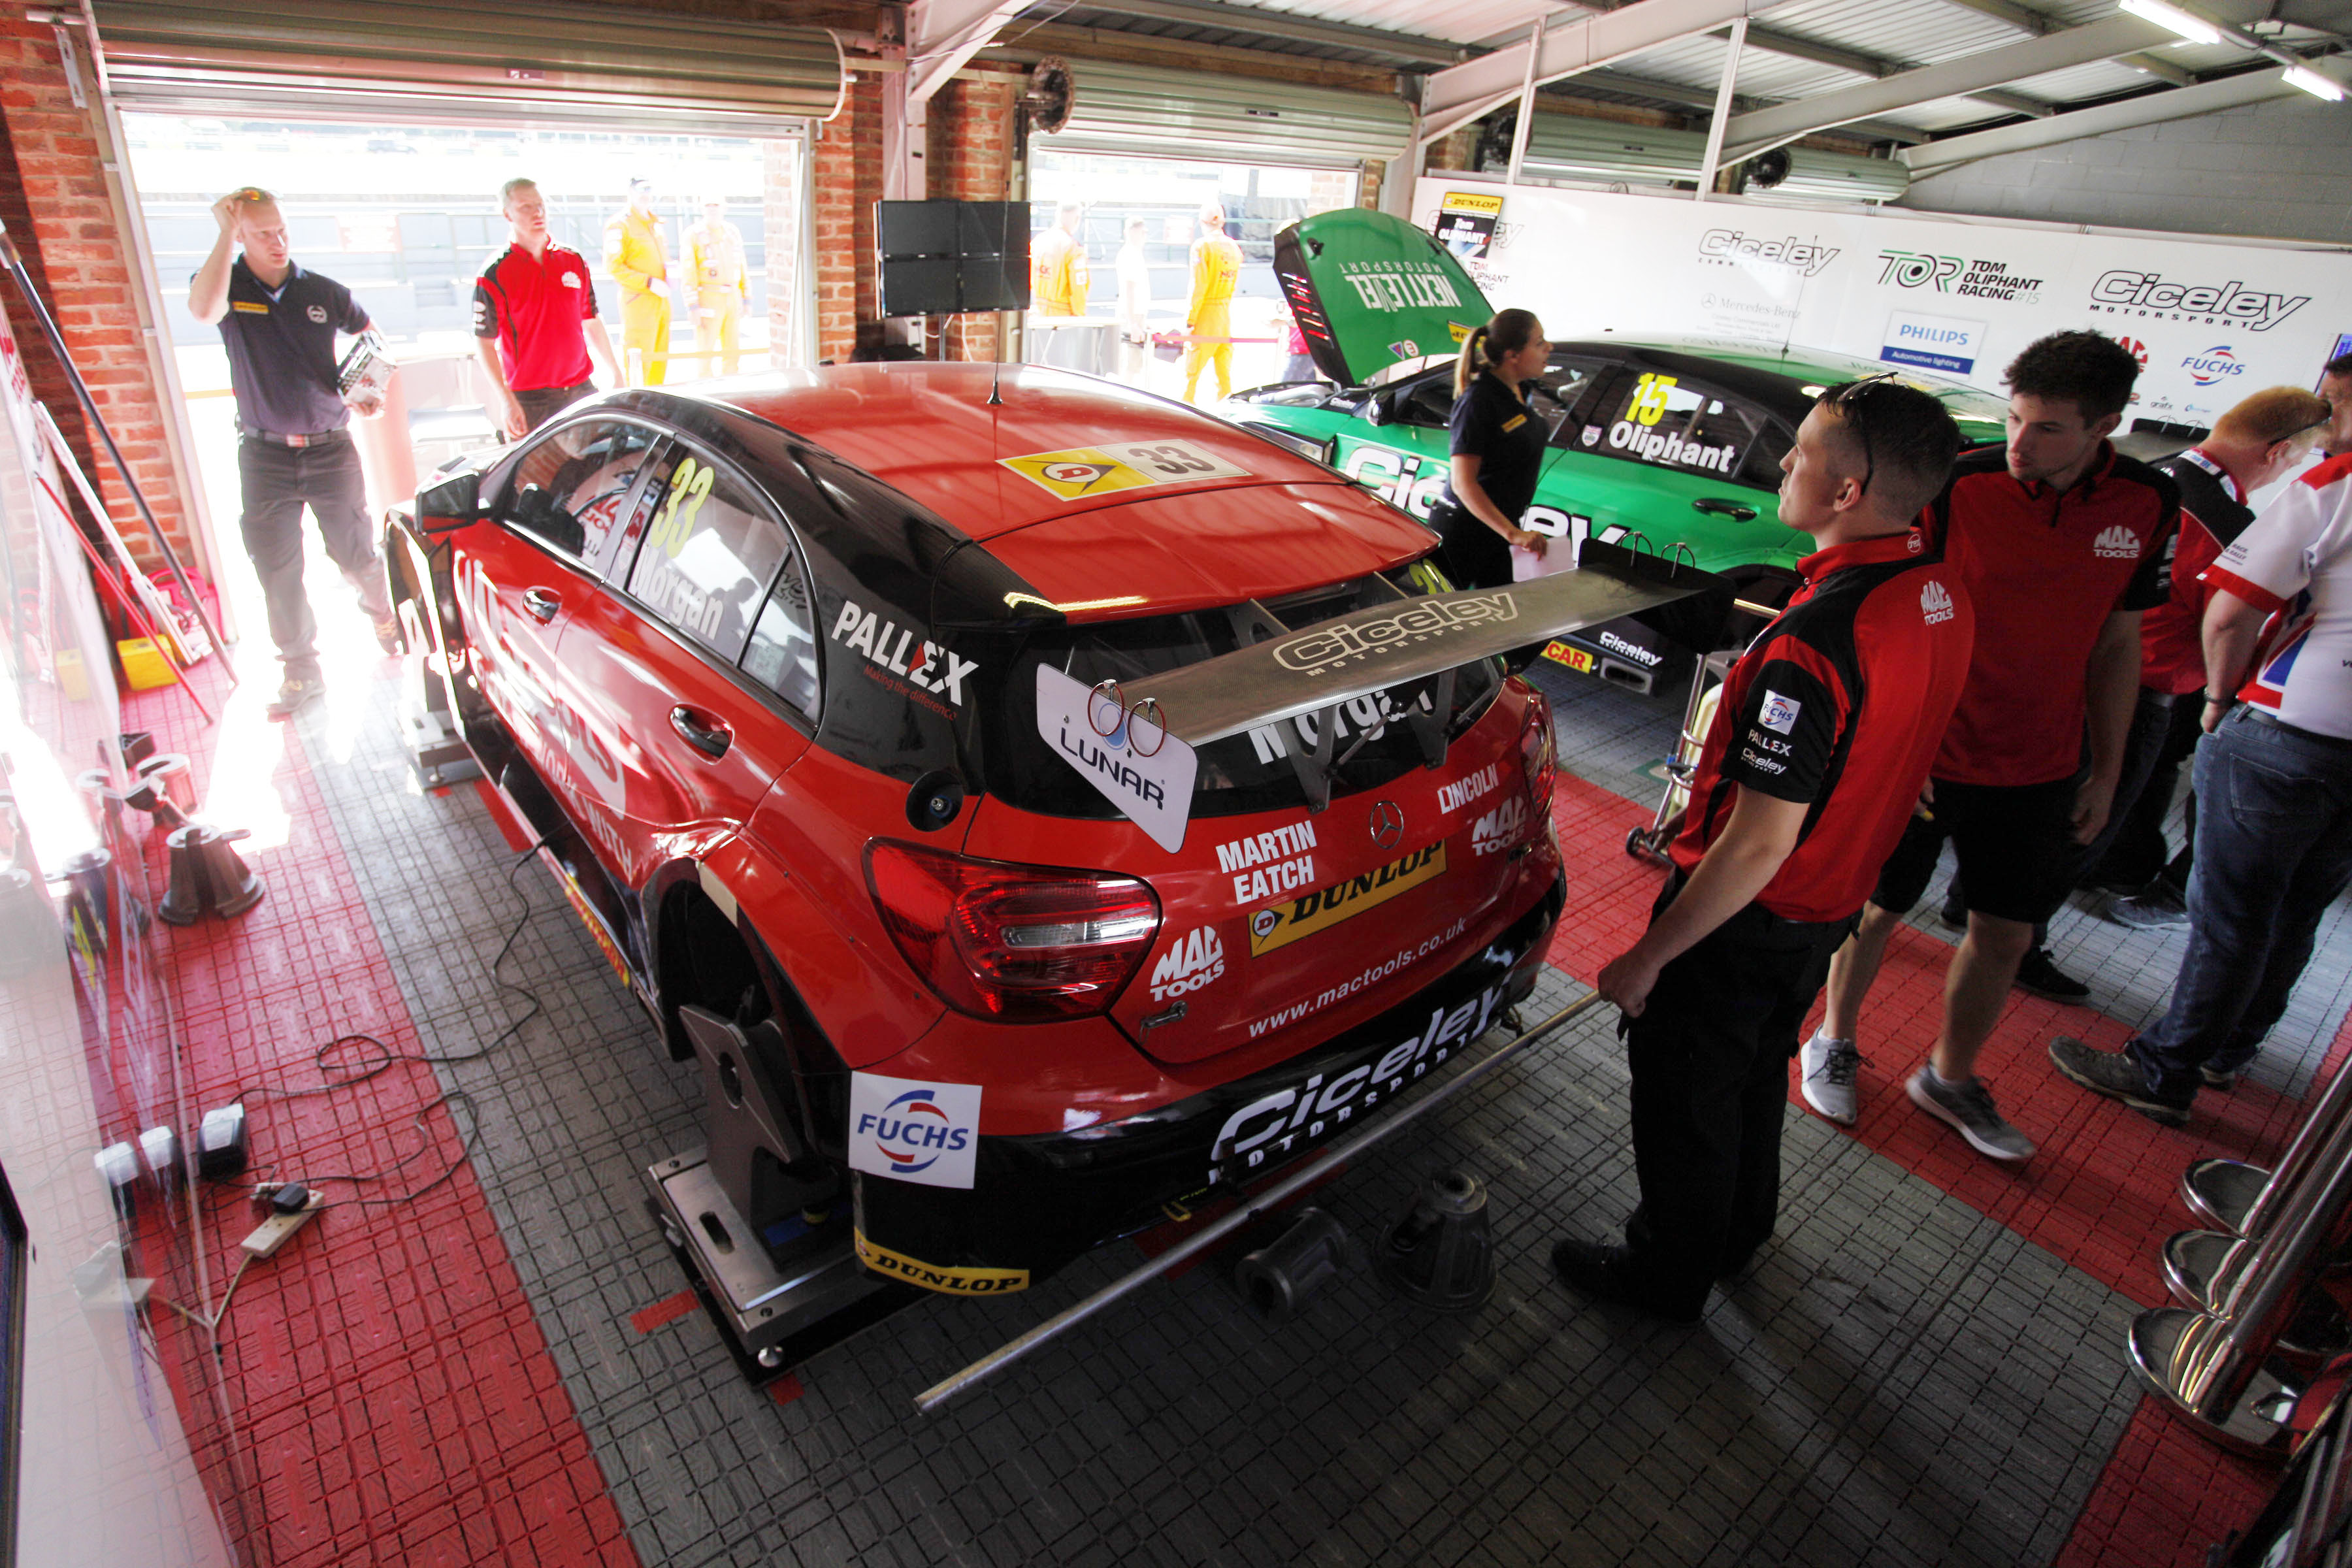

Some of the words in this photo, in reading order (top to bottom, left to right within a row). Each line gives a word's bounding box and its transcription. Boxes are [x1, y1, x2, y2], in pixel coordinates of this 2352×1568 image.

[1453, 199, 1498, 208] DUNLOP
[1438, 228, 1487, 244] OLIPHANT
[1454, 218, 1475, 231] Tom
[1338, 261, 1444, 274] MOTORSPORT
[1699, 229, 1841, 277] Ciceley
[1878, 249, 1965, 293] TOR
[1971, 260, 2006, 274] TOM
[1343, 273, 1406, 313] LEVEL
[1406, 273, 1462, 308] NEXT
[1469, 270, 1510, 284] LIPHANT
[1957, 284, 2016, 301] RACING
[1963, 272, 2043, 291] OLIPHANT
[1720, 298, 1802, 319] Mercedes-Benz
[2089, 304, 2249, 329] MOTORSPORT
[2091, 270, 2313, 331] Ciceley
[1899, 324, 1970, 346] PHILIPS
[1891, 351, 1932, 365] Automotive
[1932, 357, 1961, 370] lighting
[2180, 357, 2246, 376] FUCHS
[1625, 372, 1678, 427] 15
[1128, 446, 1217, 474] 33
[1609, 420, 1735, 473] Oliphant
[651, 457, 715, 559] 33
[2093, 525, 2140, 549] MAC
[2093, 549, 2140, 559] TOOLS
[627, 543, 724, 641] Morgan
[1921, 580, 1952, 614] MAC
[1273, 592, 1519, 671] Ciceley
[1924, 608, 1954, 626] TOOLS
[830, 600, 979, 707] PALLEX
[1307, 615, 1500, 678] MOTORSPORT
[1547, 643, 1586, 670] CAR
[1599, 631, 1663, 666] Ciceley
[863, 664, 894, 691] Making
[894, 680, 909, 696] the
[910, 689, 958, 721] difference
[1763, 704, 1794, 721] FUCHS
[1748, 728, 1792, 757] PALLEX
[1060, 727, 1165, 811] LUNAR
[1437, 762, 1499, 815] LINCOLN
[1471, 794, 1527, 842] MAC
[1215, 819, 1317, 874] MARTIN
[1471, 823, 1525, 857] TOOLS
[1233, 855, 1315, 905] EATCH
[1288, 837, 1443, 925] DUNLOP
[1150, 925, 1224, 987] MAC
[1149, 958, 1225, 1002] TOOLS
[1249, 916, 1467, 1038] www.mactools.co.uk
[1210, 970, 1514, 1161] Ciceley
[857, 1113, 969, 1151] FUCHS
[875, 1254, 1022, 1292] DUNLOP
